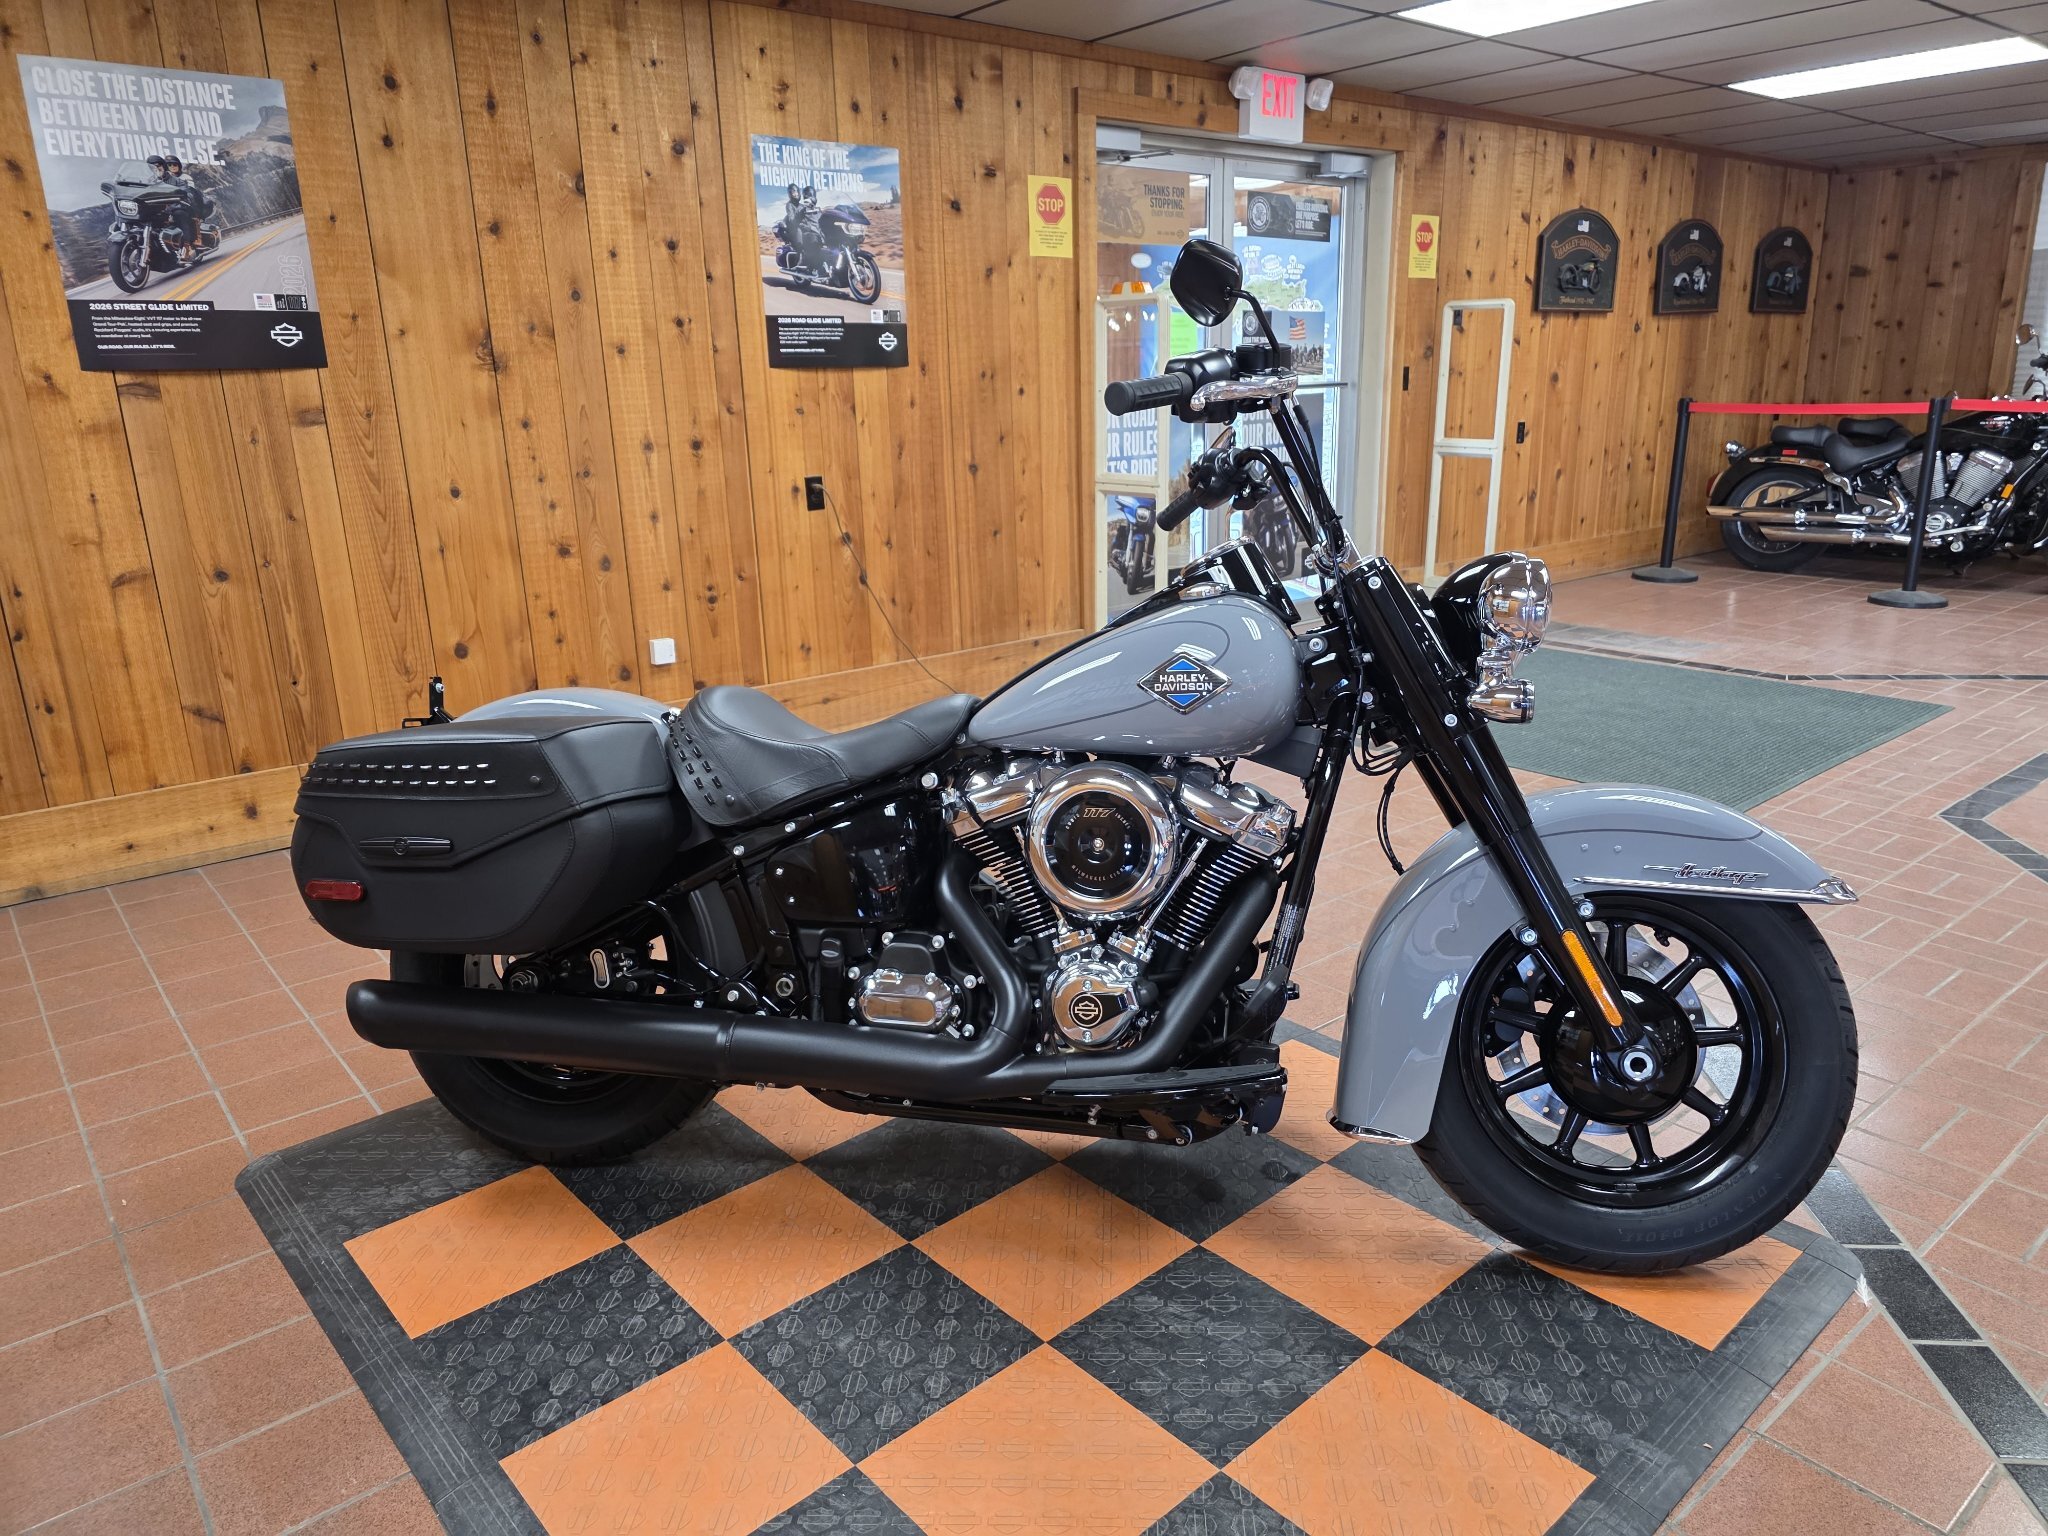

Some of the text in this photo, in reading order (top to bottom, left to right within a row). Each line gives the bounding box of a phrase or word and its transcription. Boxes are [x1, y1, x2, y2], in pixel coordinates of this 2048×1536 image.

[31, 66, 236, 110] CLOSE THE DISTANCE
[1260, 72, 1297, 119] EXIT
[37, 97, 223, 137] BETWEEN YOU AND
[43, 128, 226, 166] EVERYTHING ELSE.
[757, 142, 850, 170] THE KING OF THE
[760, 165, 812, 188] HIGHWAY
[1143, 184, 1185, 199] THANKS FOR
[1038, 197, 1064, 212] STOP
[1150, 197, 1185, 210] STOPPING.
[1416, 231, 1433, 243] STOP
[148, 303, 174, 311] GLIDE
[175, 303, 209, 311] LIMITED
[1242, 422, 1263, 448] OUR
[1159, 673, 1209, 683] HARLEY-
[1154, 682, 1213, 692] DAVIDSON
[1083, 807, 1116, 818] 117
